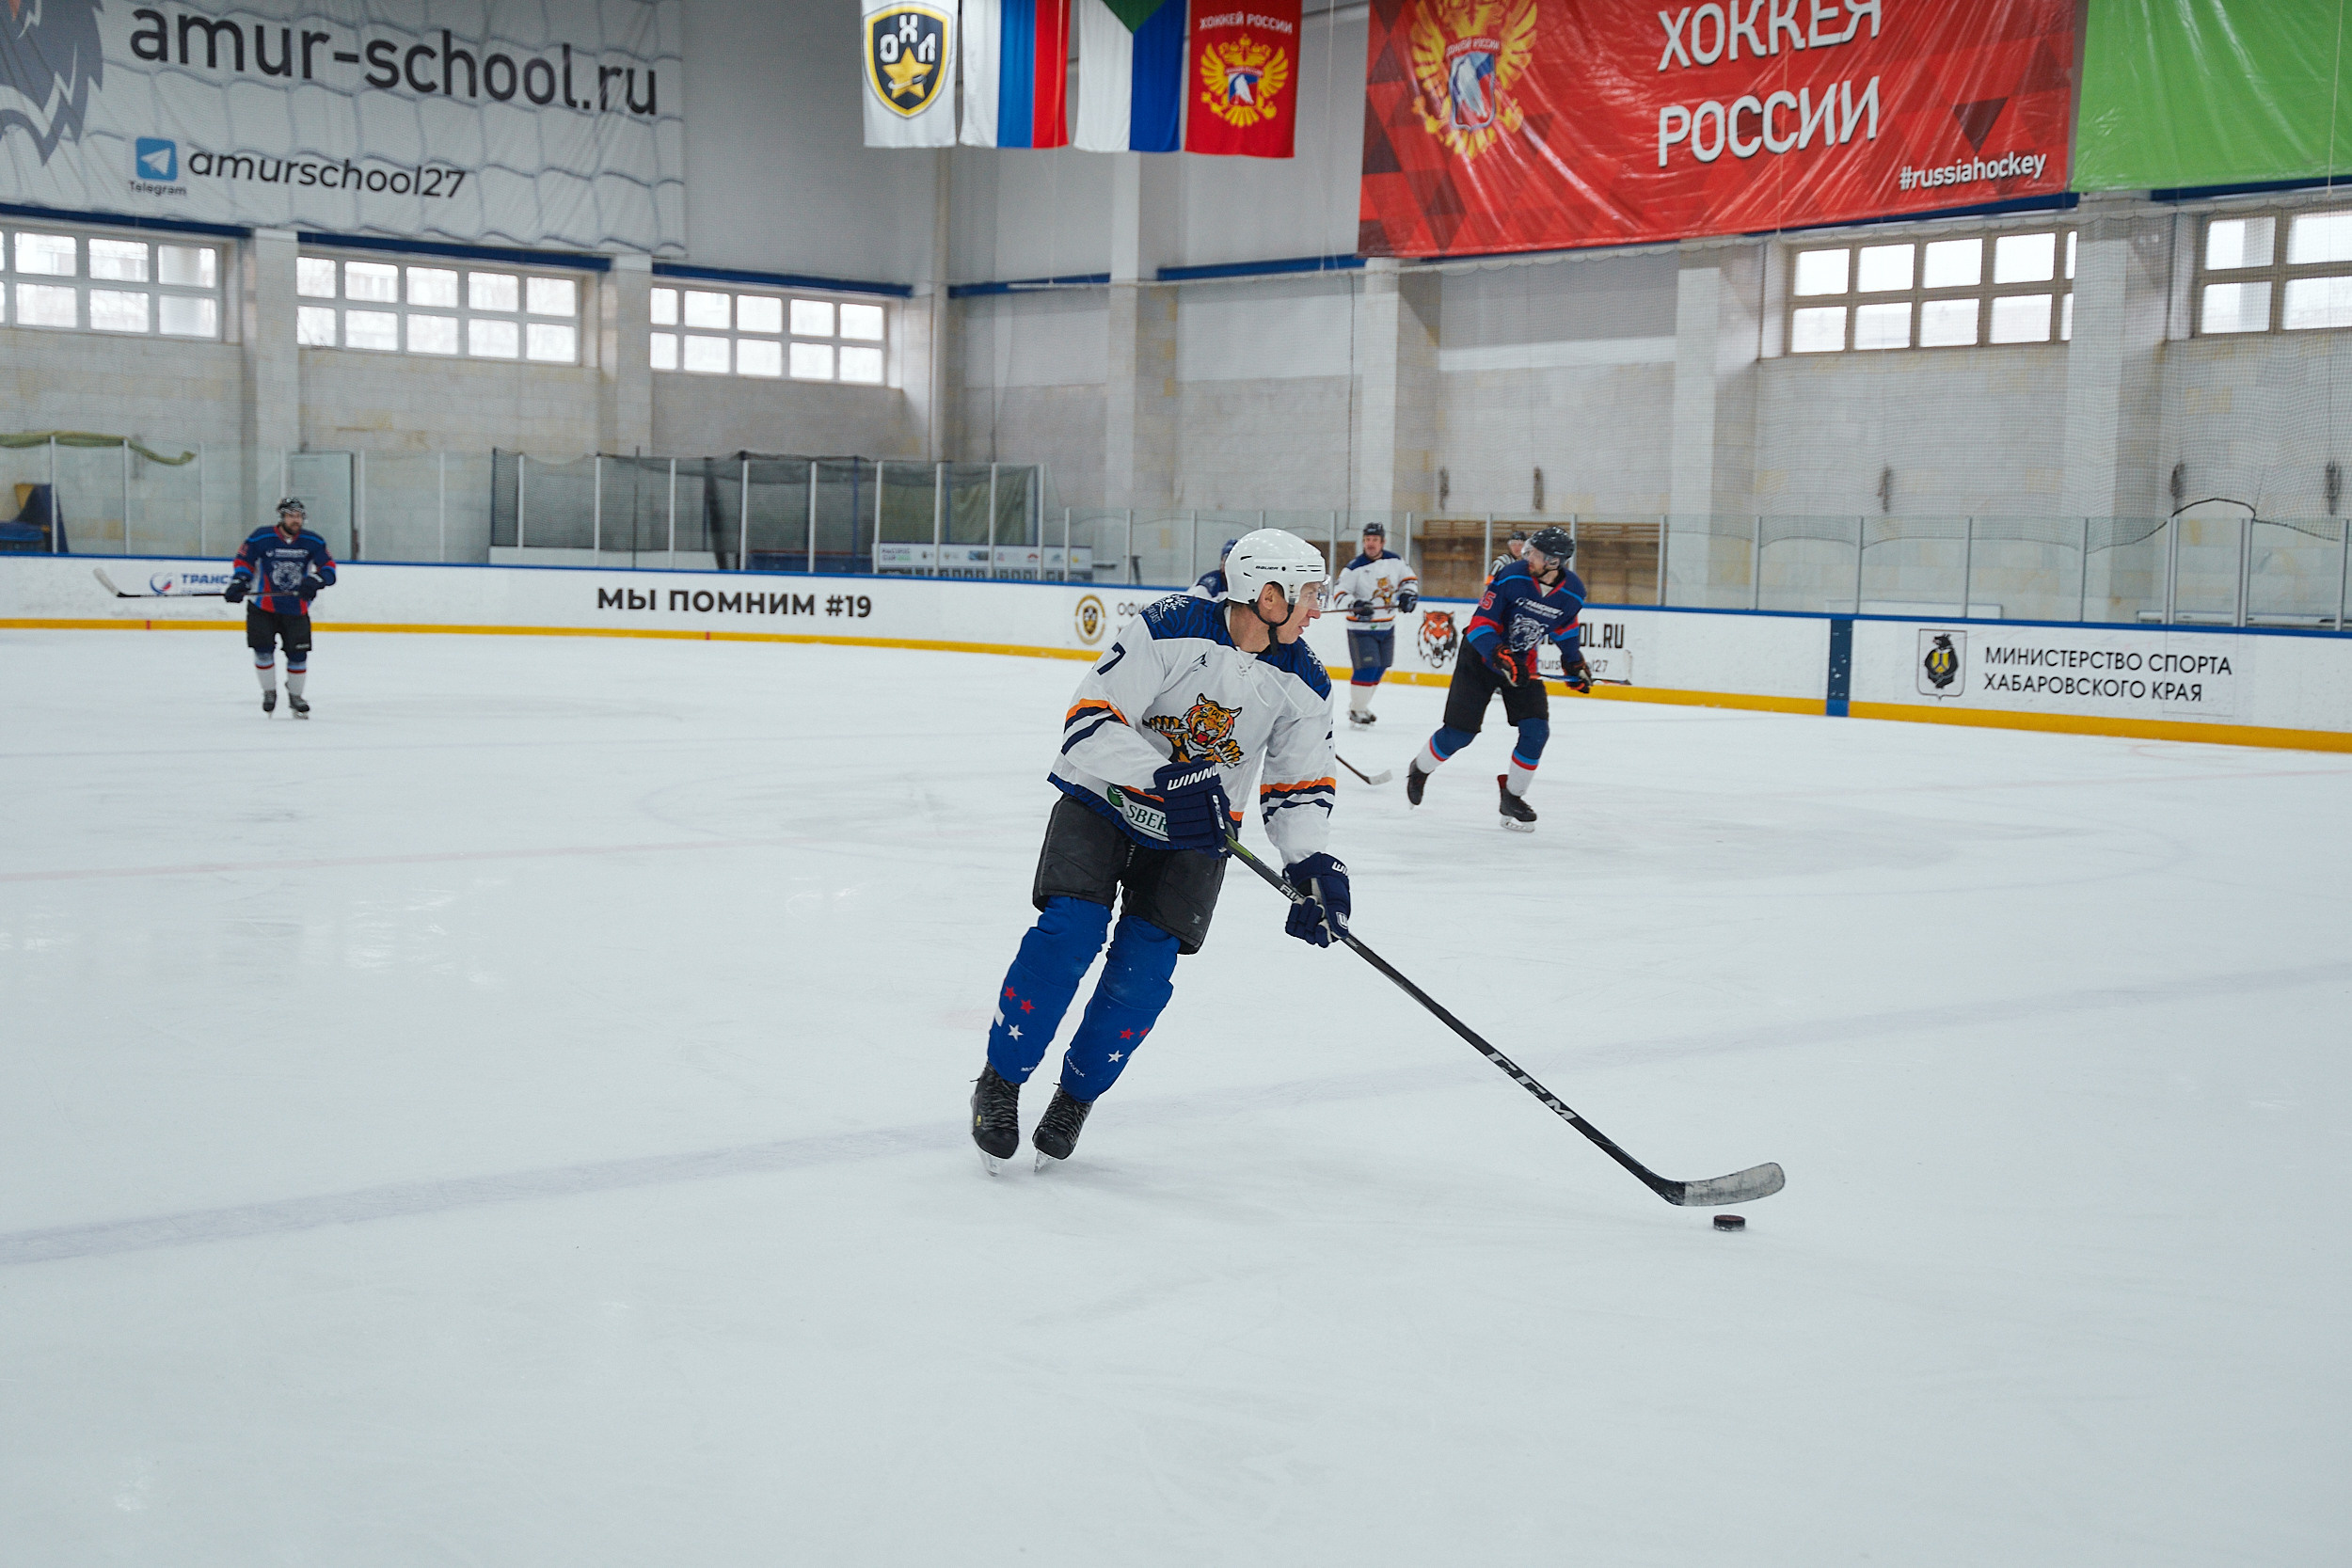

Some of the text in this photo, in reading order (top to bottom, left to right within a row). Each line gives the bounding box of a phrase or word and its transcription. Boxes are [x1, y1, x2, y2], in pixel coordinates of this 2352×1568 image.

[1200, 11, 1293, 35] ХОККЕЙ РОССИИ
[130, 8, 657, 116] amur-school.ru
[1658, 75, 1881, 168] РОССИИ
[188, 150, 467, 198] amurschool27
[1899, 150, 2047, 191] #russiahockey
[128, 180, 187, 198] Telegram
[597, 588, 872, 618] МЫ ПОМНИМ #19
[1985, 646, 2233, 675] МИНИСТЕРСТВО СПОРТА
[1983, 673, 2202, 702] ХАБАРОВСКОГО КРАЯ
[1487, 1052, 1578, 1120] CCM
